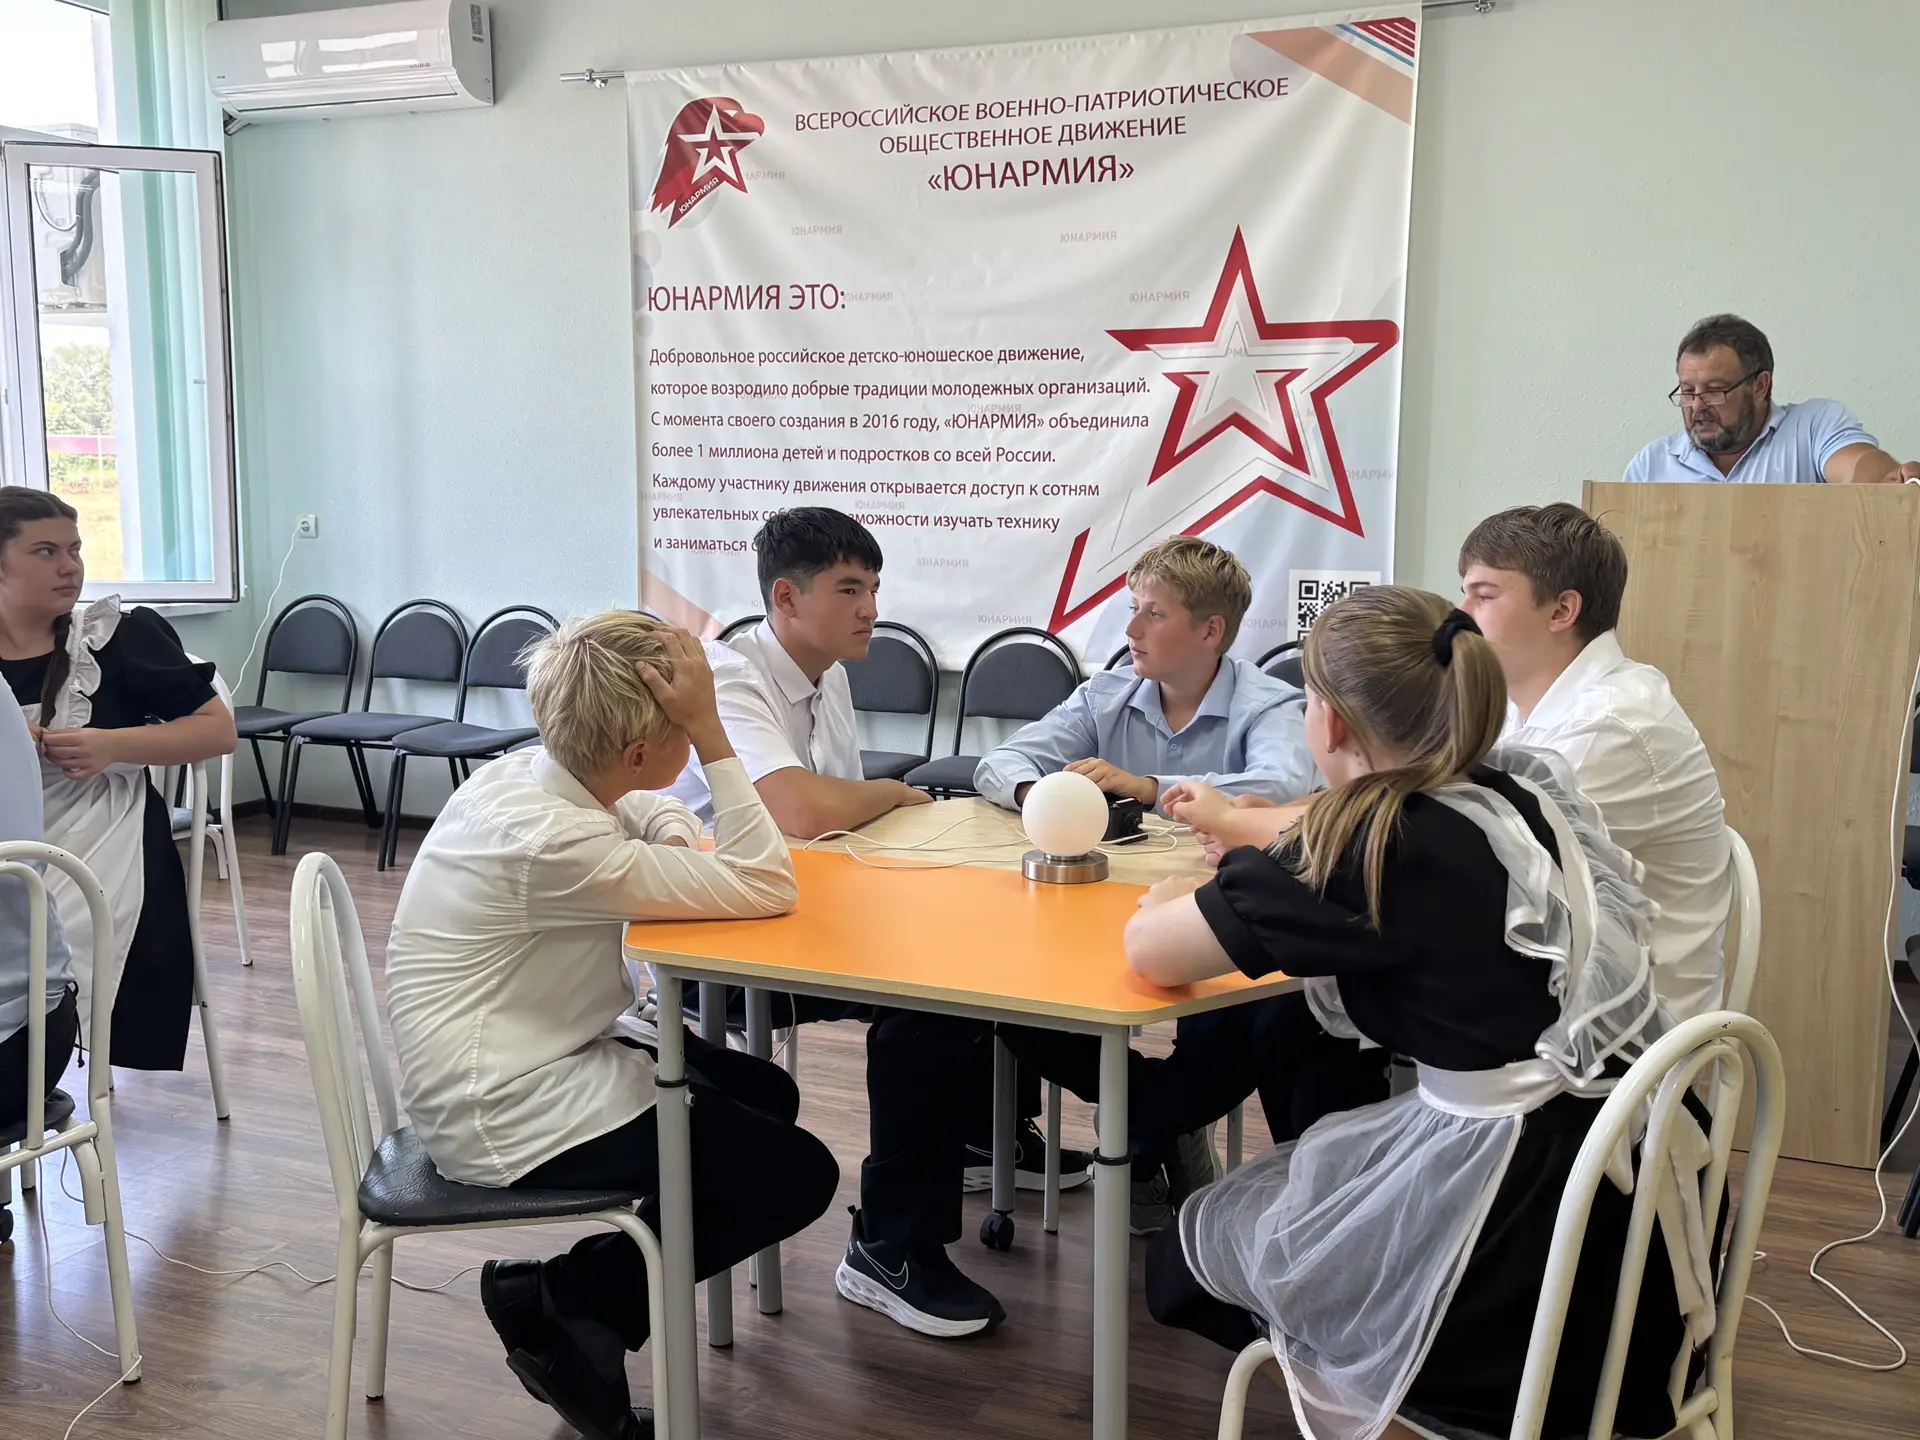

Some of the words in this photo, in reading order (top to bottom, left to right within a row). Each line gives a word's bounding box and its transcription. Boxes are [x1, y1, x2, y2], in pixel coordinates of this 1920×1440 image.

[796, 103, 968, 131] ВСЕРОССИЙСКОЕ
[976, 77, 1289, 120] ВОЕННО-ПАТРИОТИЧЕСКОЕ
[880, 125, 1052, 155] ОБЩЕСТВЕННОЕ
[1058, 116, 1186, 146] ДВИЖЕНИЕ
[927, 155, 1134, 191] «ЮНАРМИЯ»
[679, 177, 720, 213] ЮНАРМИЯ
[648, 285, 780, 311] ЮНАРМИЯ
[789, 283, 845, 310] ЭТО:
[649, 347, 755, 366] Добровольное
[758, 347, 846, 366] российское
[847, 349, 994, 366] детско-юношеское
[996, 347, 1085, 364] движение,
[650, 383, 708, 398] которое
[711, 383, 789, 398] возродило
[791, 379, 850, 399] добрые
[852, 384, 928, 400] традиции
[931, 382, 1035, 398] молодежных
[1037, 376, 1151, 399] организаций.
[650, 410, 661, 425] С
[663, 414, 724, 426] момента
[727, 415, 776, 427] своего
[779, 415, 846, 430] создания
[849, 416, 859, 428] в
[861, 413, 900, 428] 2016
[903, 416, 940, 432] году,
[943, 412, 1045, 429] «ЮНАРМИЯ»
[1048, 411, 1149, 431] объединила
[651, 441, 694, 457] более
[697, 443, 704, 458] 1
[708, 446, 779, 459] миллиона
[781, 444, 824, 462] детей
[827, 447, 836, 460] и
[840, 448, 930, 464] подростков
[933, 449, 952, 462] со
[955, 446, 992, 462] всей
[995, 446, 1056, 462] России.
[652, 473, 717, 492] Каждому
[718, 477, 791, 493] участнику
[792, 479, 867, 494] движения
[869, 481, 967, 497] открывается
[969, 483, 1025, 499] доступ
[1029, 483, 1039, 495] к
[1041, 483, 1100, 496] сотням
[652, 507, 760, 521] увлекательных
[933, 515, 994, 530] изучать
[995, 516, 1061, 533] технику
[653, 537, 663, 548] и
[665, 537, 748, 551] заниматься
